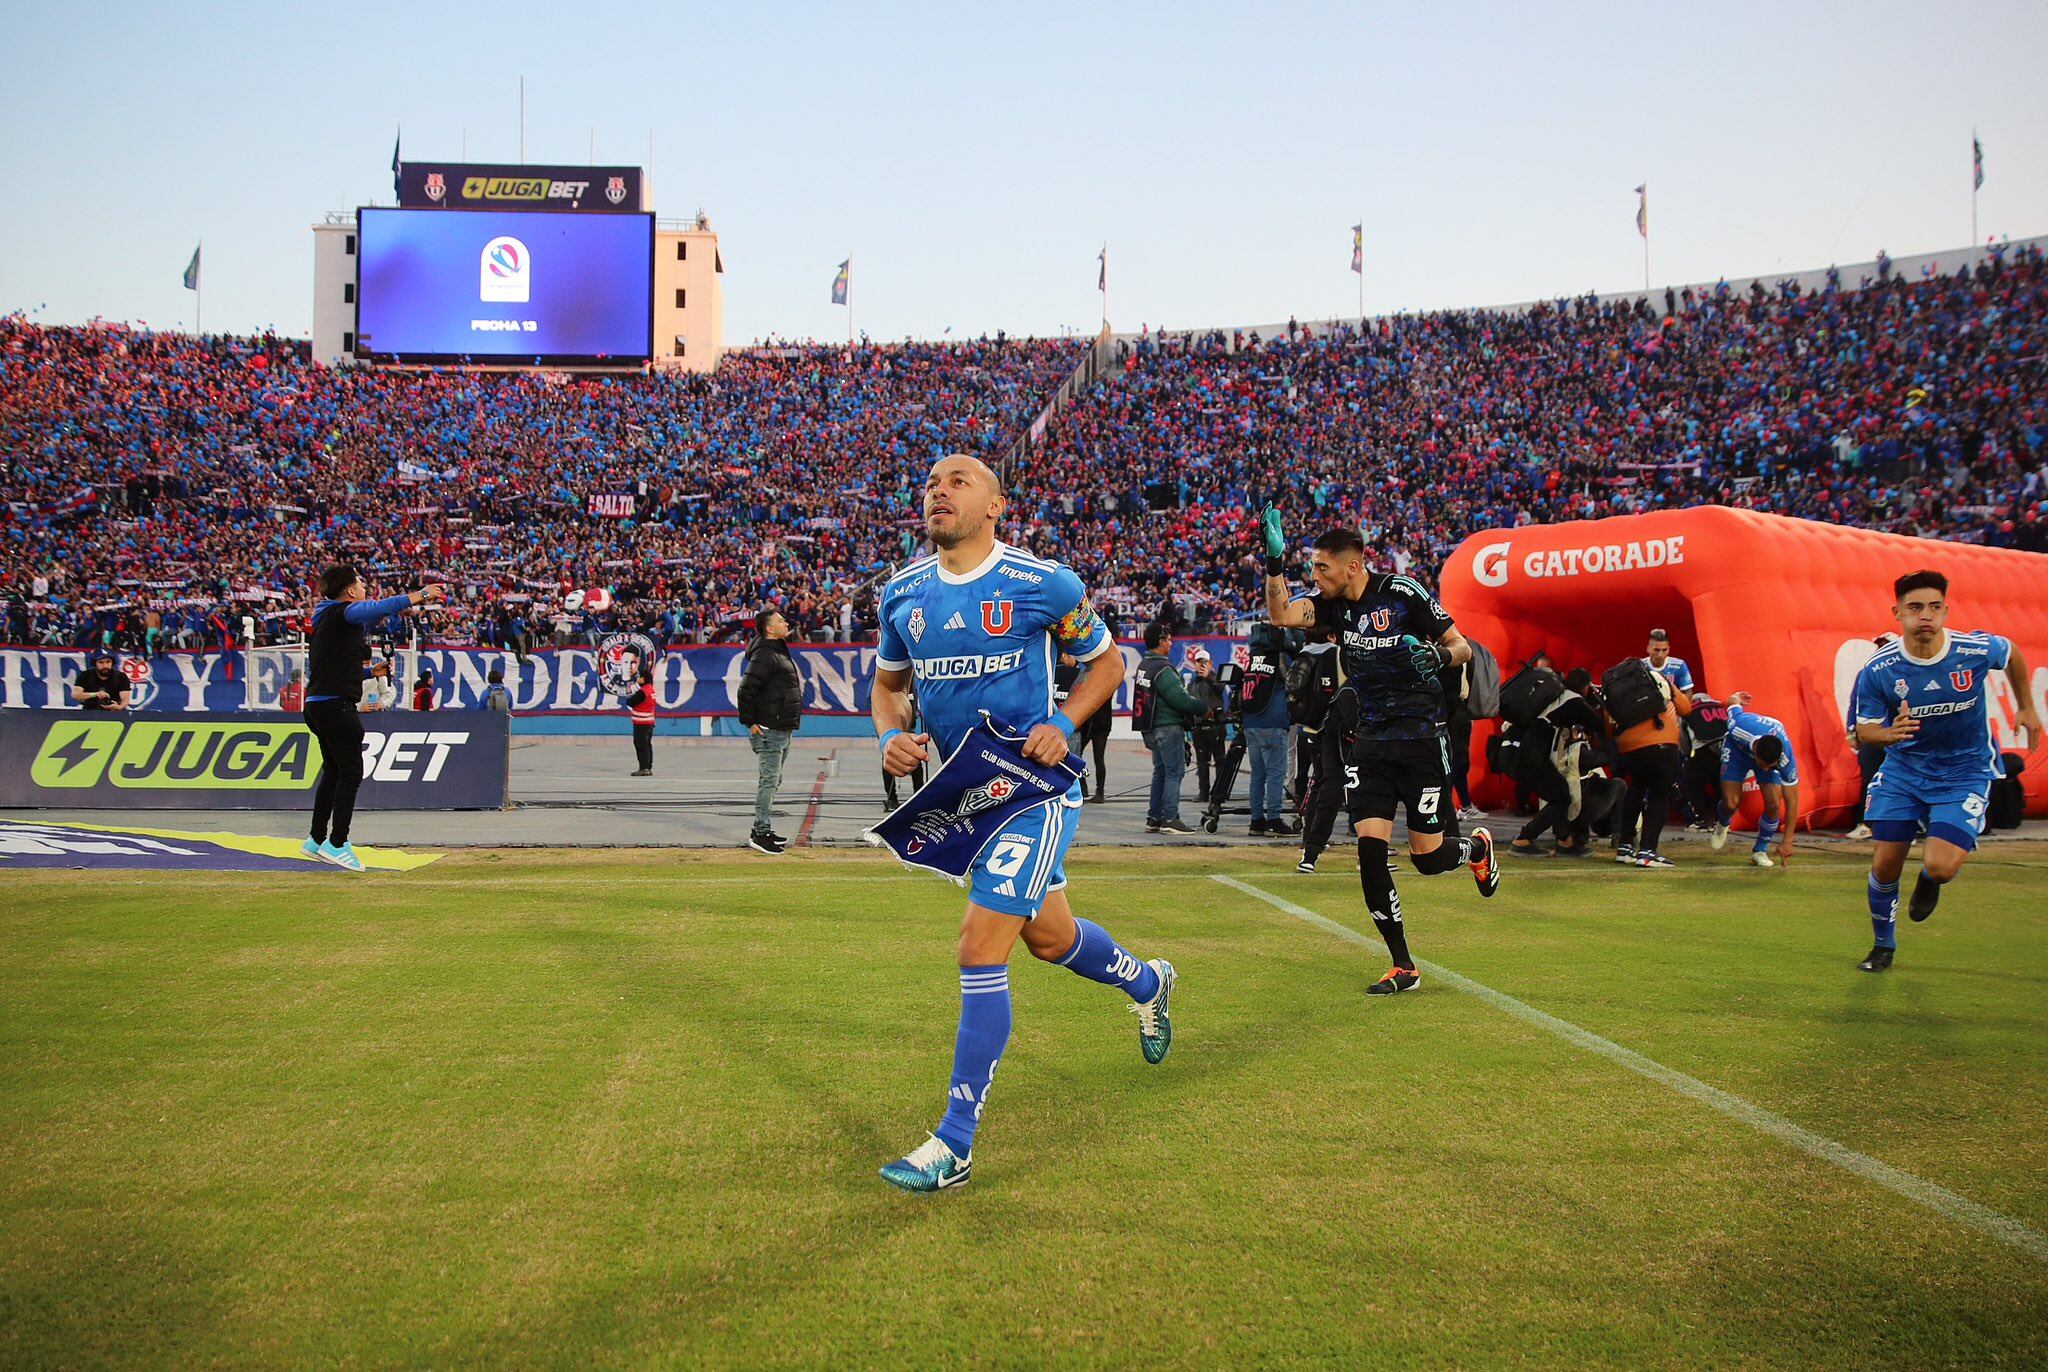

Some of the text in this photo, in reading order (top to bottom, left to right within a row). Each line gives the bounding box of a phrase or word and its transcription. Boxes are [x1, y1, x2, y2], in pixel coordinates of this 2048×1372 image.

[471, 319, 538, 332] FECHA 13
[1523, 535, 1685, 578] GATORADE
[894, 571, 932, 596] MACH
[998, 564, 1043, 584] Impeke
[980, 600, 1013, 637] U
[1871, 654, 1901, 673] MACH
[981, 750, 1055, 793] CLUB UNIVERSIDAD DE CHILE
